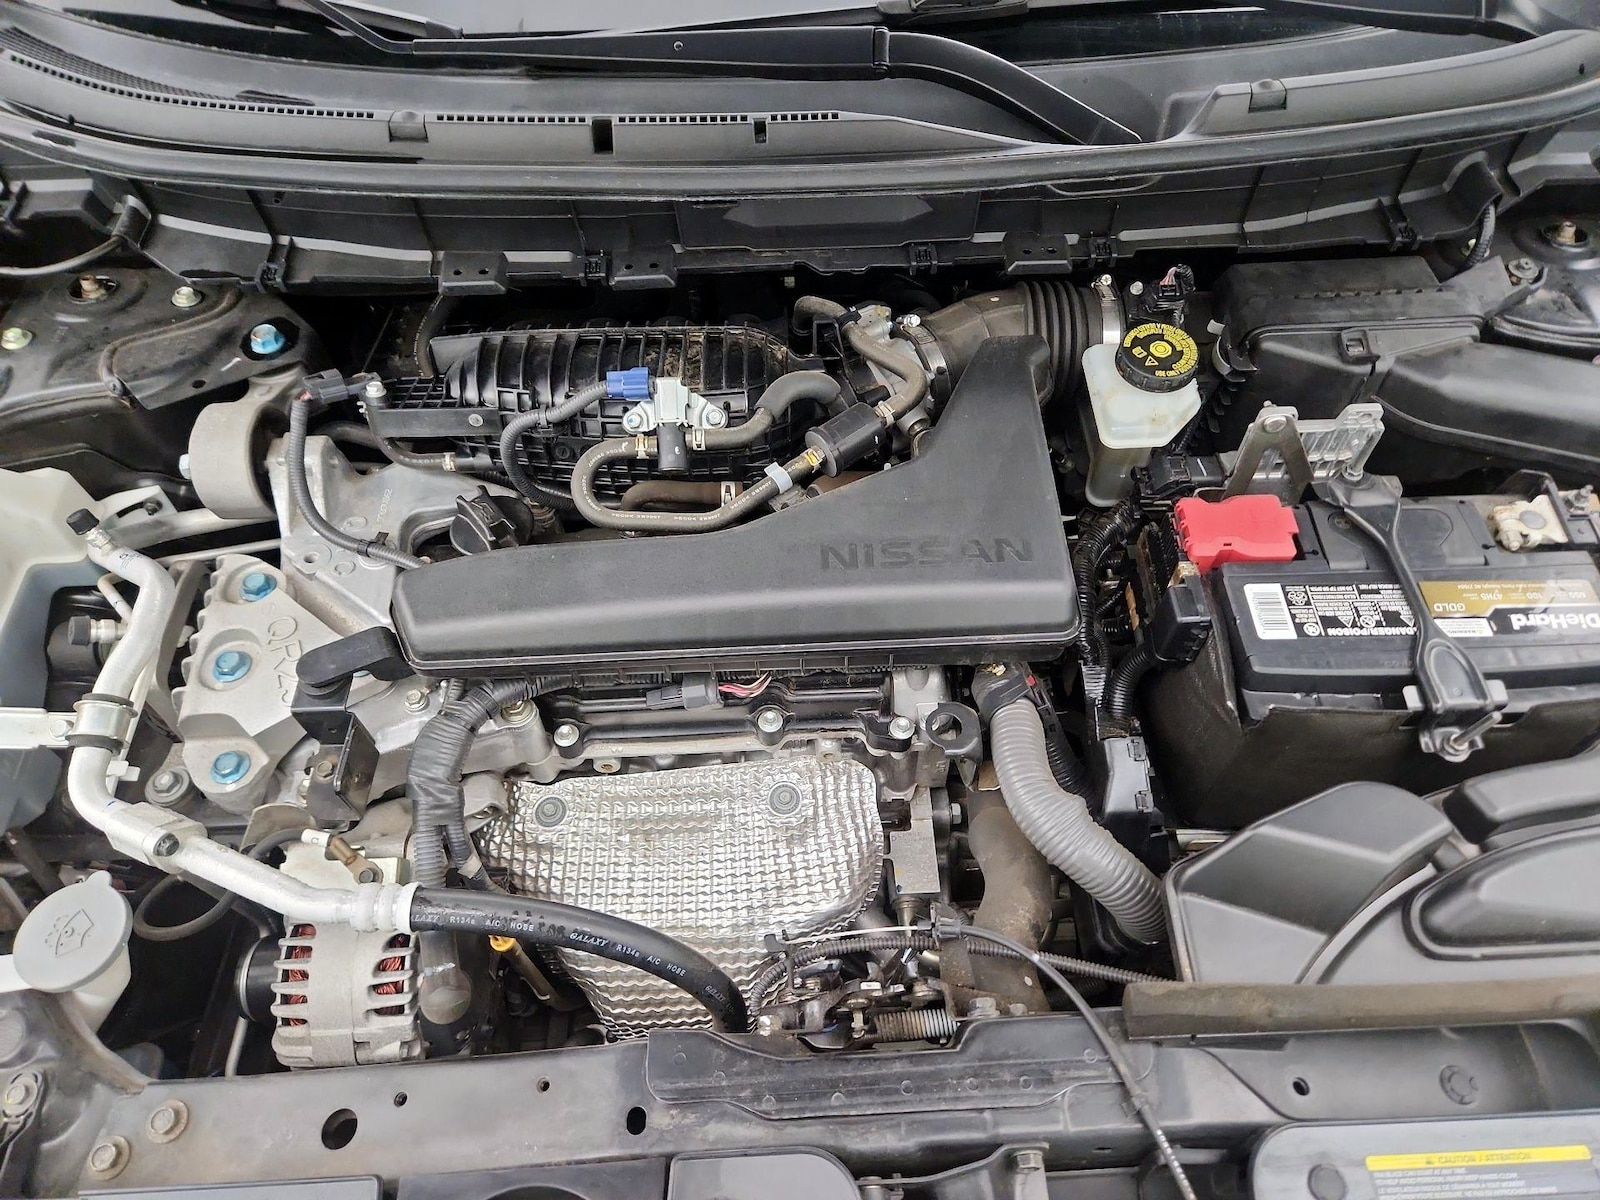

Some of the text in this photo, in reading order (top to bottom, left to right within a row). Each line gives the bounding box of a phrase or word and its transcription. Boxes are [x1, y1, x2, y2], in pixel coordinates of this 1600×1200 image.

[819, 537, 1033, 571] NISSAN
[1434, 602, 1466, 612] GOLD
[1509, 613, 1600, 630] DieHard
[449, 915, 475, 925] R134a
[485, 919, 501, 927] A/C
[510, 921, 534, 932] HOSE
[569, 932, 686, 977] GALAXY R134a A/C HOSE
